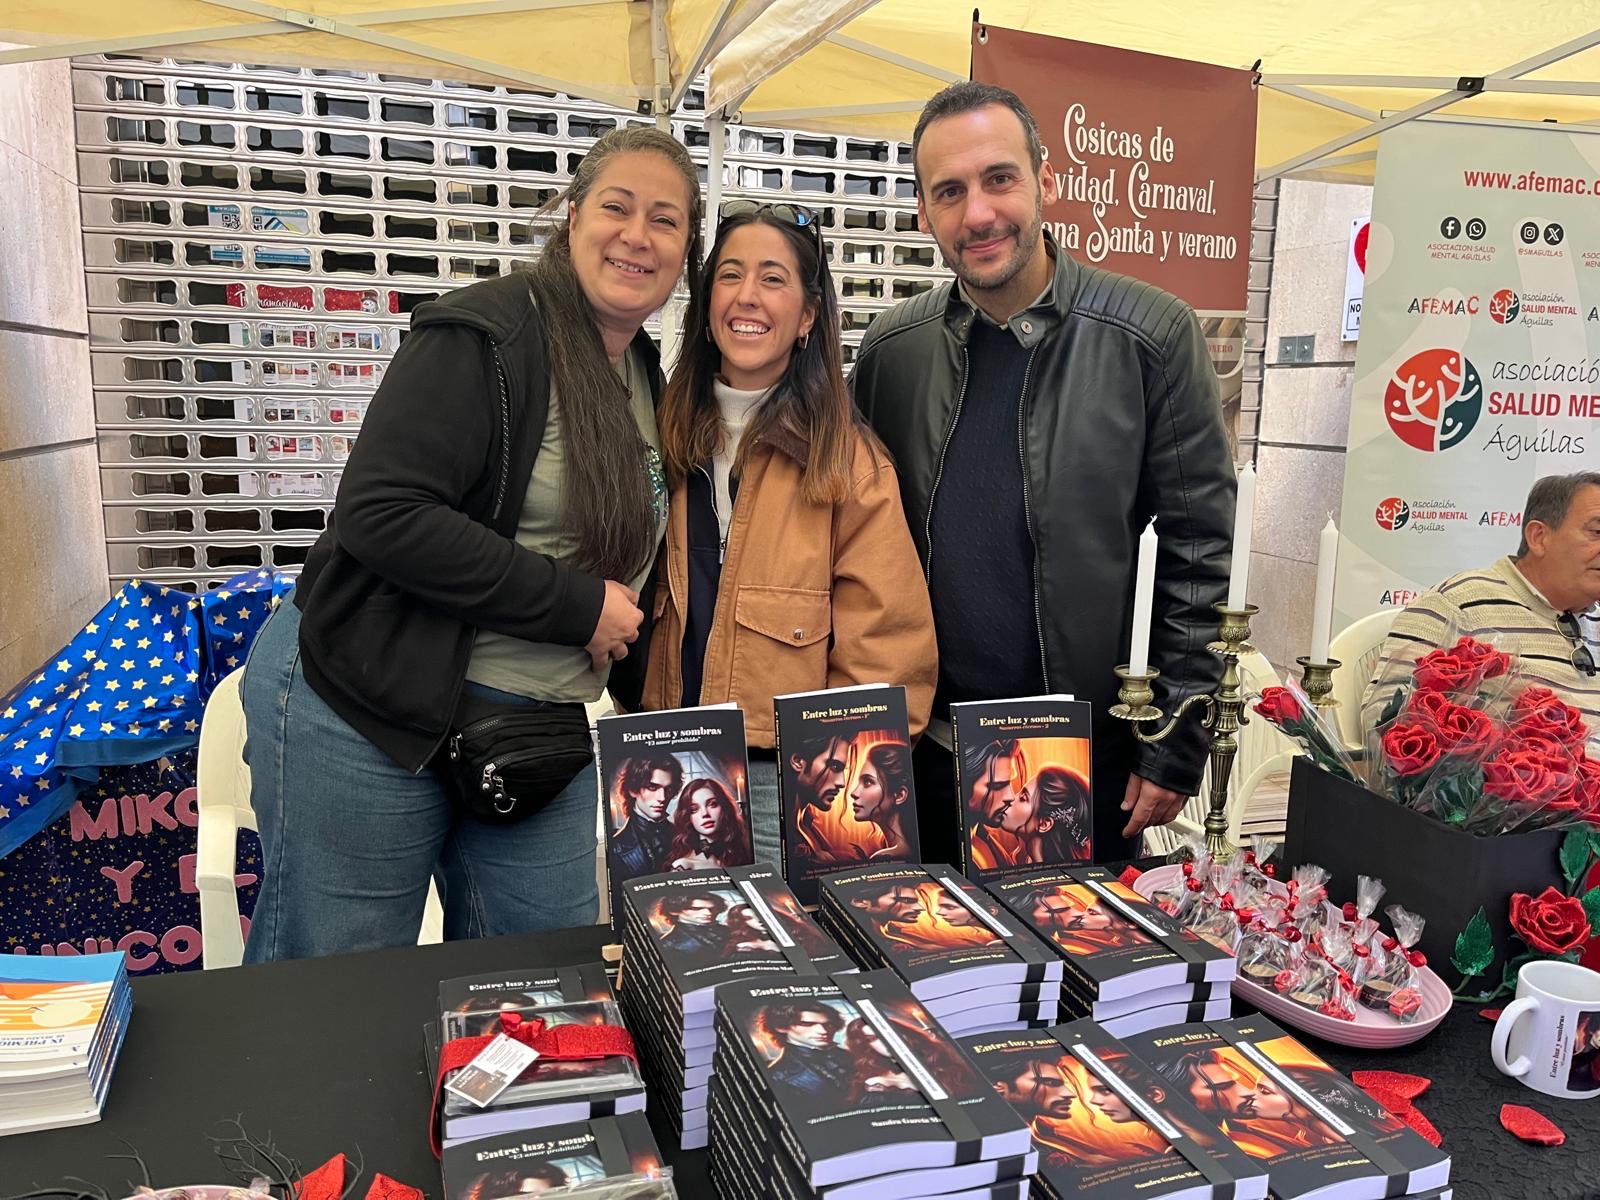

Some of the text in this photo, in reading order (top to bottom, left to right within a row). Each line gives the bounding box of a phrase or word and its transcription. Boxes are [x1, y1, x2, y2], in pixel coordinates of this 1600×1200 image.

[1063, 103, 1174, 165] Cosicas de
[1054, 161, 1217, 219] vidad, Carnaval,
[1085, 201, 1155, 263] Santa
[1159, 230, 1173, 263] y
[1178, 231, 1237, 260] verano
[1430, 252, 1491, 262] MENTAL AGUILAS
[1473, 245, 1496, 254] SALUD
[1408, 296, 1480, 316] AFEMAC
[1520, 303, 1578, 315] SALUD MENTAL
[1488, 391, 1600, 418] SALUD ME
[1411, 510, 1469, 521] SALUD MENTAL
[1478, 511, 1522, 527] AFEM
[802, 703, 888, 720] Entre luz y sombras
[979, 714, 1070, 727] Entre luz y sombras
[622, 726, 722, 743] Entre luz y sombras
[100, 860, 145, 904] Y
[633, 881, 666, 892] Entre
[469, 982, 504, 991] Entre
[504, 980, 525, 988] luz
[525, 979, 532, 987] y
[749, 986, 789, 998] Entre
[789, 985, 812, 993] luz
[973, 1042, 1009, 1054] Entre
[1008, 1039, 1028, 1048] luz
[1027, 1040, 1034, 1048] y
[1153, 1035, 1186, 1047] Entre
[1185, 1033, 1205, 1041] luz
[1204, 1032, 1211, 1040] y
[871, 1117, 902, 1128] Sandra
[903, 1115, 930, 1125] García
[476, 1133, 595, 1162] Entre luz y somb
[1134, 1176, 1162, 1190] Sandra
